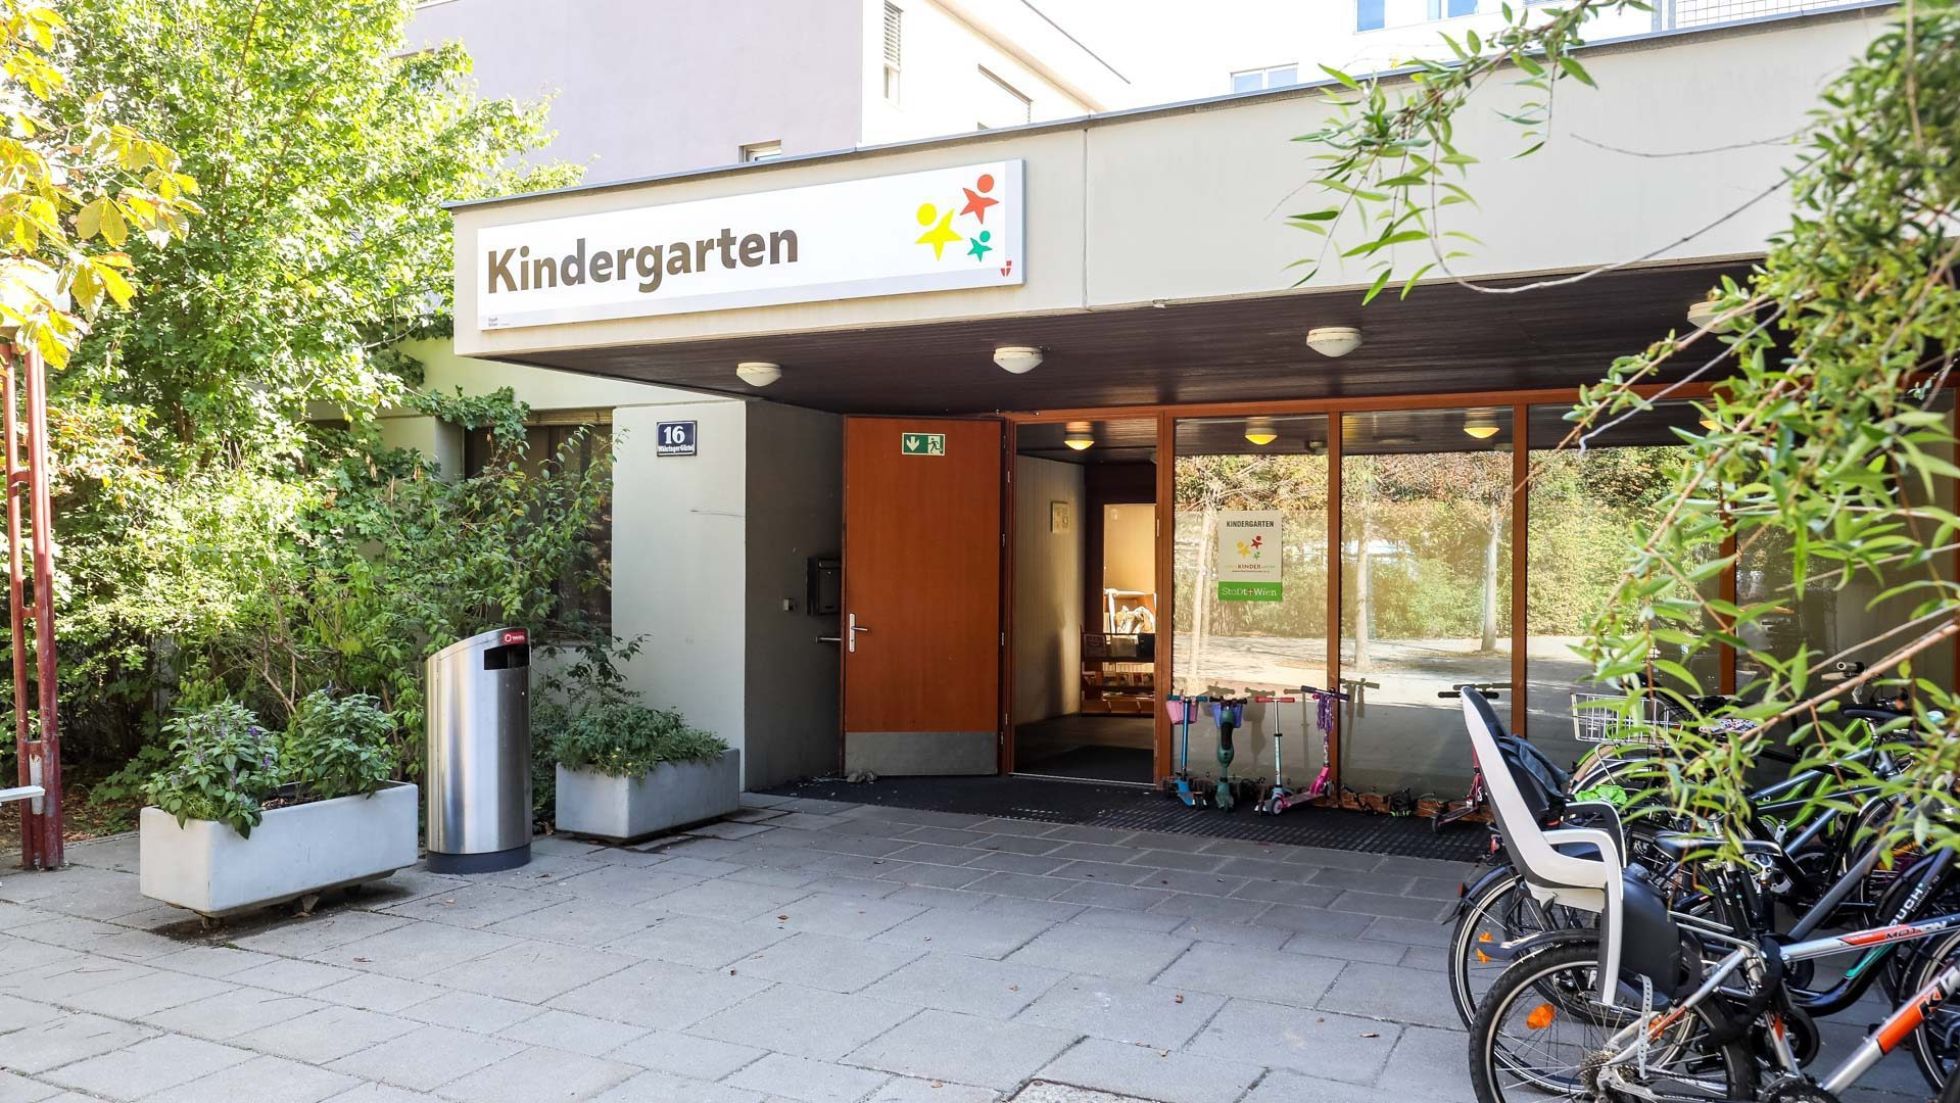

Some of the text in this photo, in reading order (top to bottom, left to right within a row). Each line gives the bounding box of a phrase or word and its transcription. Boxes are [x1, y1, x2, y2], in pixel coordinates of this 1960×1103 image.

[487, 228, 799, 293] Kindergarten
[663, 425, 685, 444] 16
[1226, 520, 1275, 528] KINDERGARTEN
